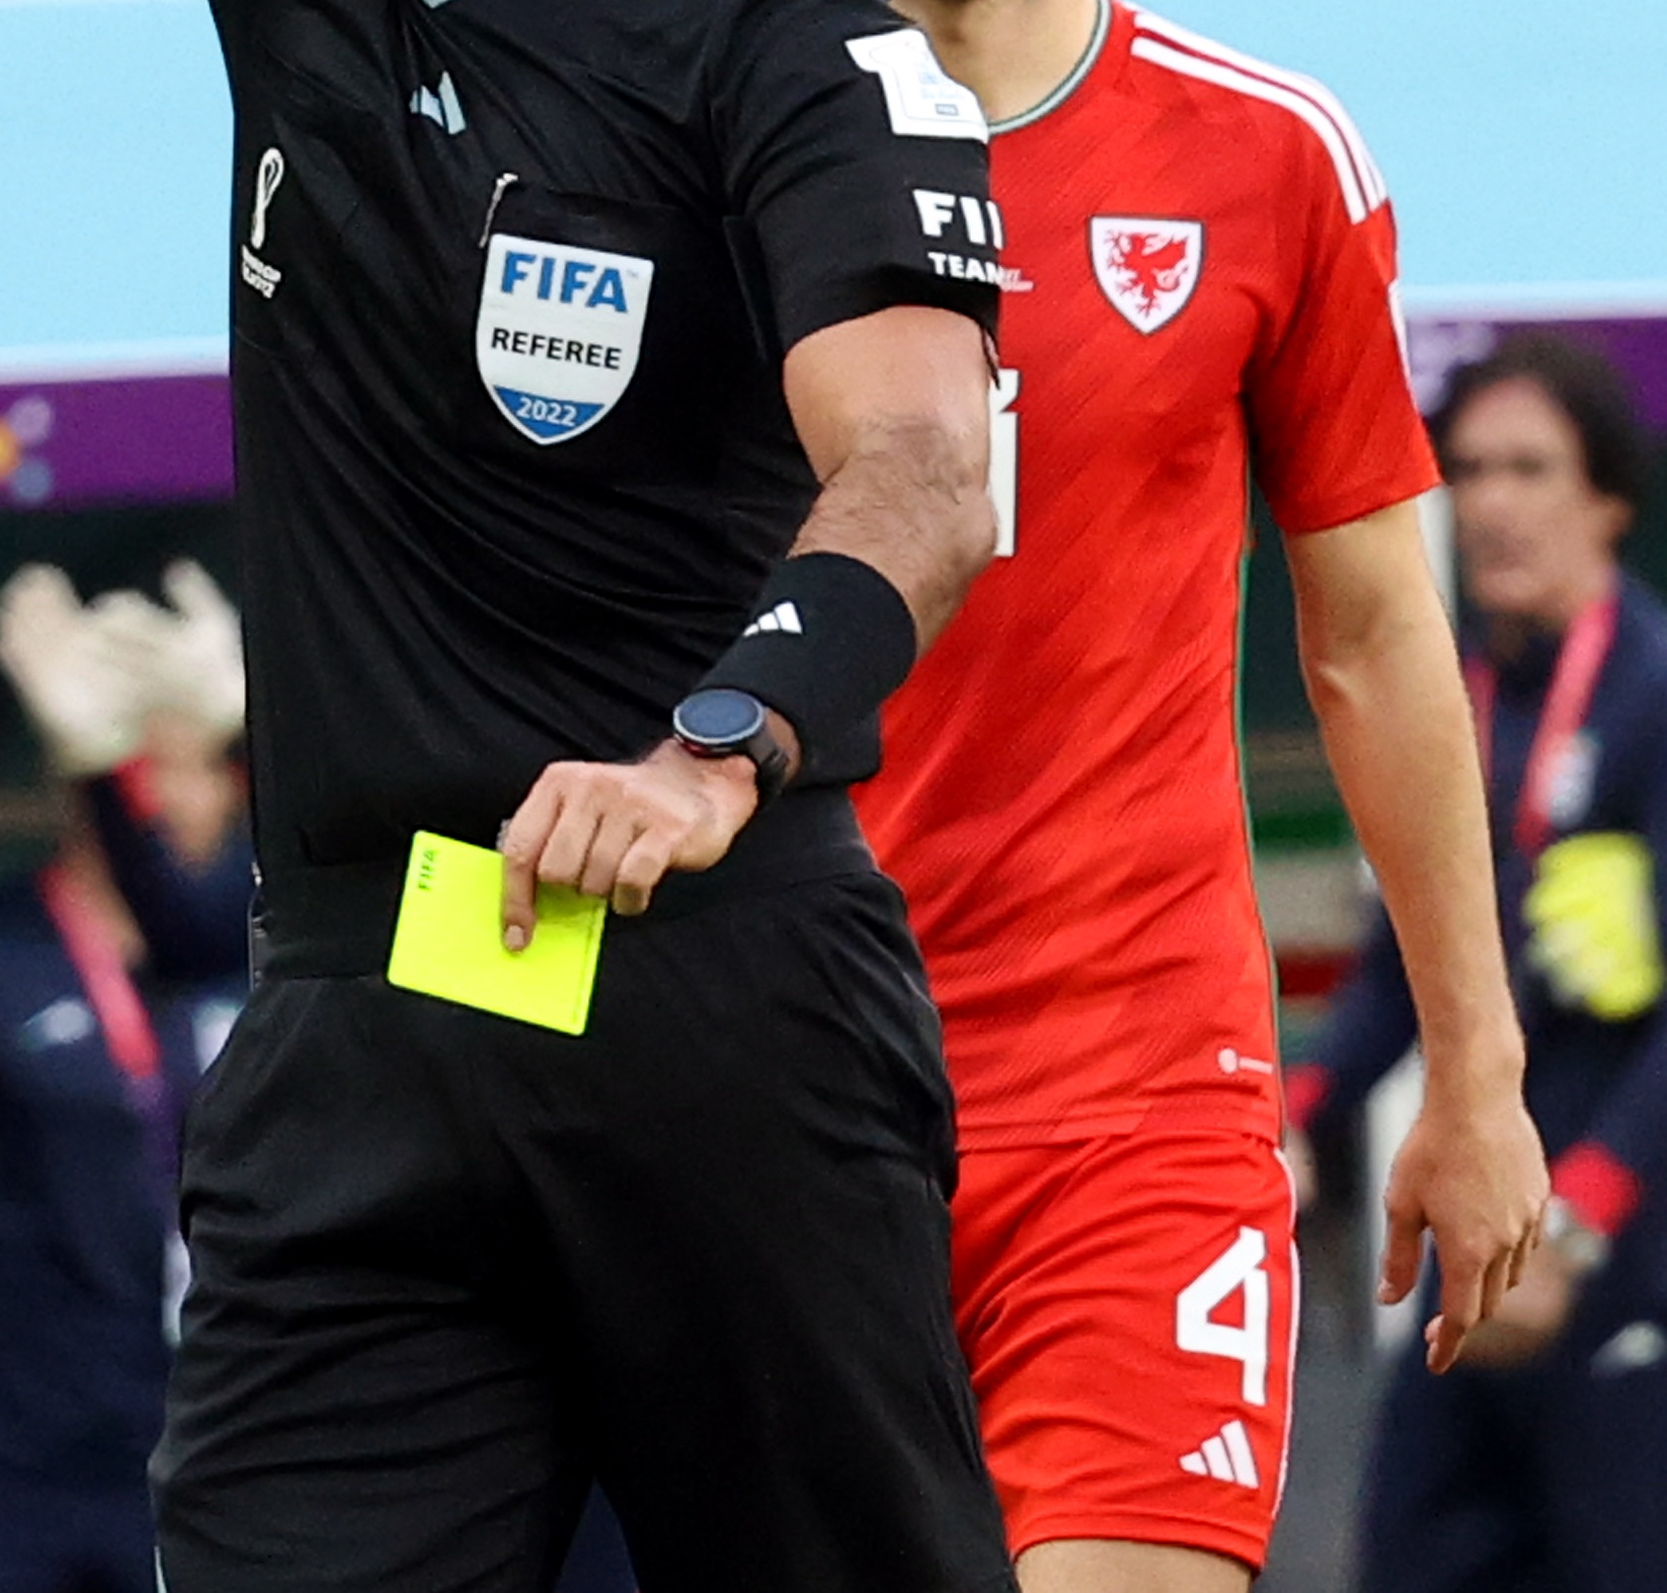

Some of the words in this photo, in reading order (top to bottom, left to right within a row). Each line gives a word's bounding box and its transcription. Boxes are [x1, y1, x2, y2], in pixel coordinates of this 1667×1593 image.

[500, 250, 629, 314] FIFA
[490, 326, 623, 371] REFEREE
[516, 396, 577, 427] 2022
[416, 846, 437, 892] FIFA
[1175, 1225, 1271, 1408] 4
